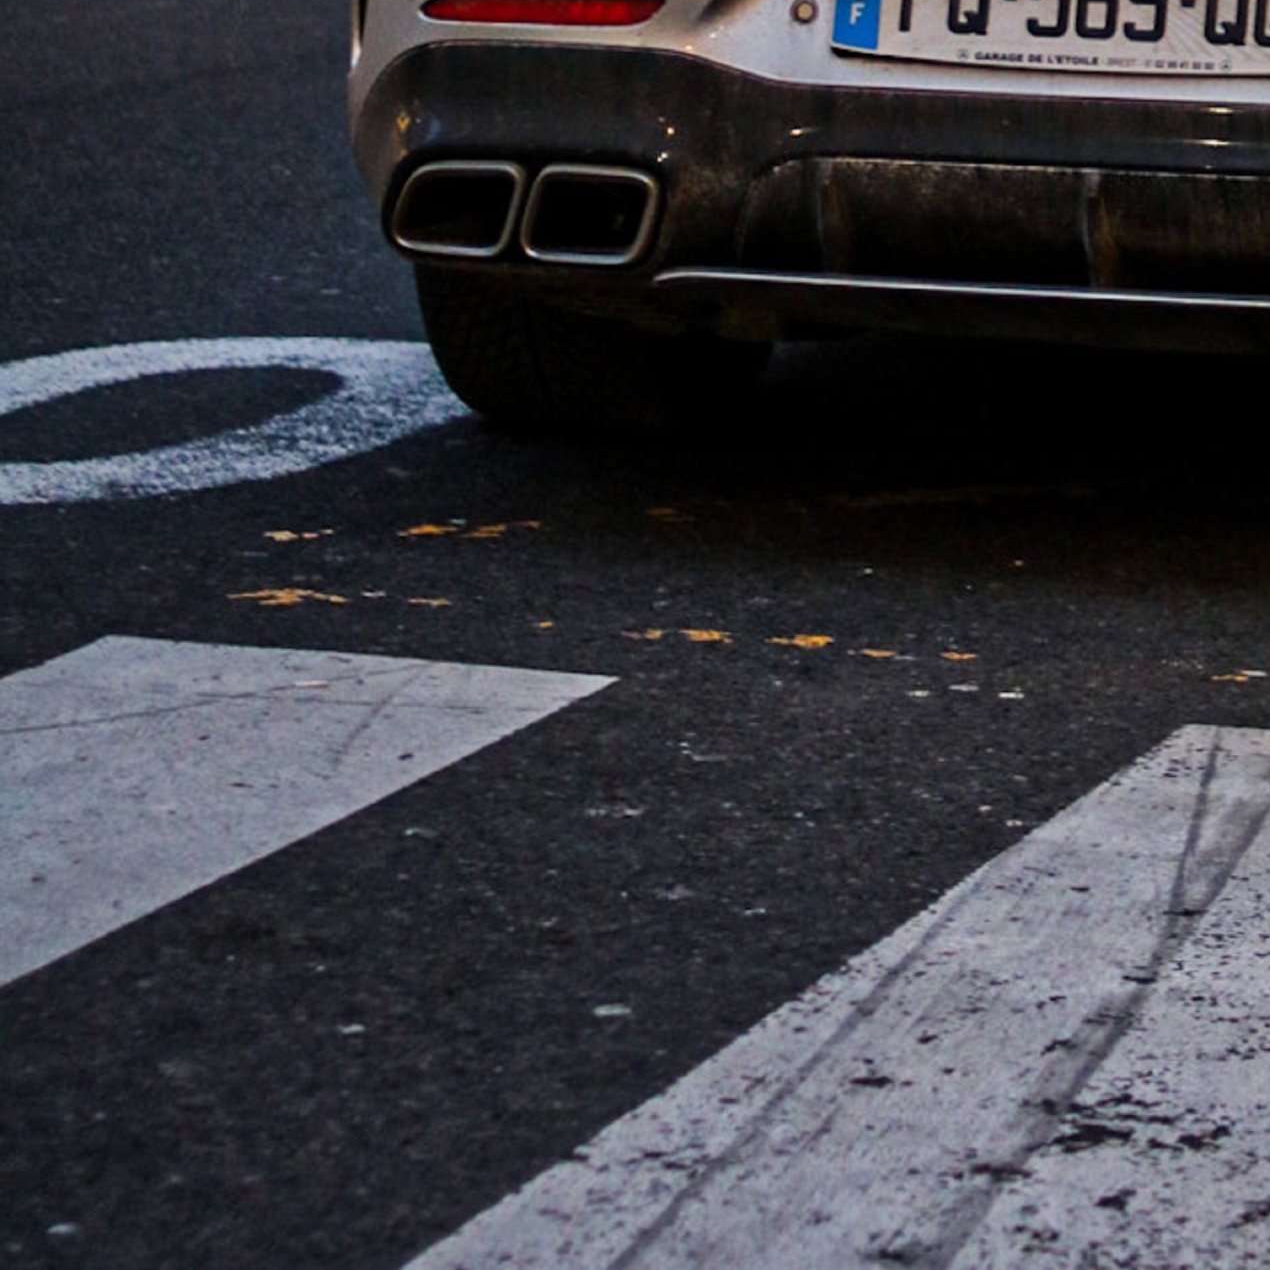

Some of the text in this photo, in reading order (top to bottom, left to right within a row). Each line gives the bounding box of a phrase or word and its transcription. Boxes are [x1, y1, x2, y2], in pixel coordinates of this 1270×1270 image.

[849, 2, 866, 26] F
[974, 51, 1024, 63] GARAGE
[1028, 53, 1042, 64] DE
